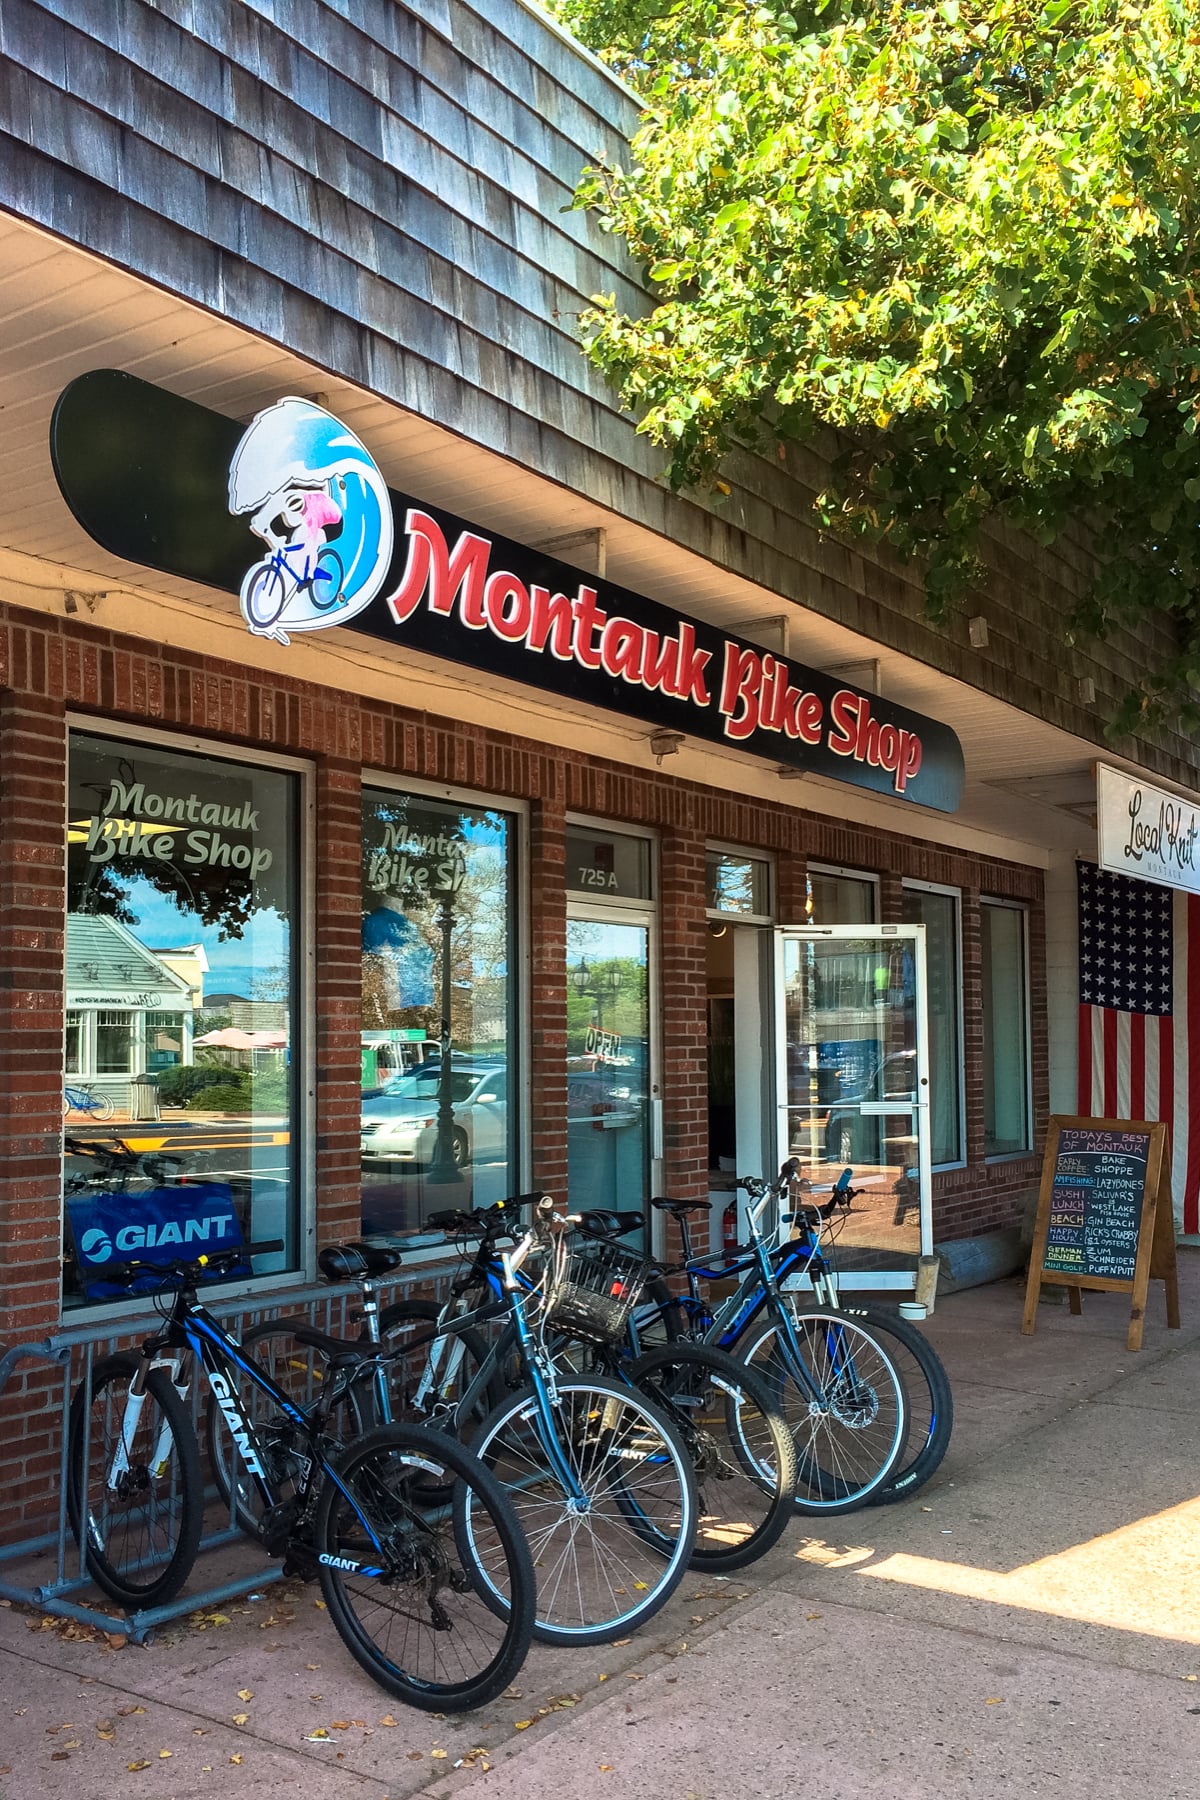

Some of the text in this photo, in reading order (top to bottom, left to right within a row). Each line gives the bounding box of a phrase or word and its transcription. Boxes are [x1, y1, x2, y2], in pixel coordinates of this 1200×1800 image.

[387, 508, 922, 792] Montauk Bike Shop
[103, 779, 260, 832] Montauk
[1125, 789, 1198, 871] Local Knit
[85, 815, 273, 880] Bike Shop
[368, 854, 429, 892] Bike
[1121, 1133, 1149, 1144] BEST
[1063, 1140, 1143, 1153] OF MONTAUK
[1101, 1155, 1127, 1165] BAKE
[1094, 1165, 1134, 1176] SHOPPE
[1096, 1177, 1144, 1190] LAZYBONES
[1053, 1189, 1085, 1199] SUSHI
[1090, 1203, 1136, 1214] WESTLAKE
[1087, 1216, 1135, 1228] GIN BEACH
[116, 1214, 233, 1251] GIANT
[1050, 1227, 1079, 1237] HAPPY
[1088, 1255, 1135, 1266] SCHNEIDER
[209, 1372, 266, 1479] GIANT
[318, 1553, 361, 1572] GIANT
